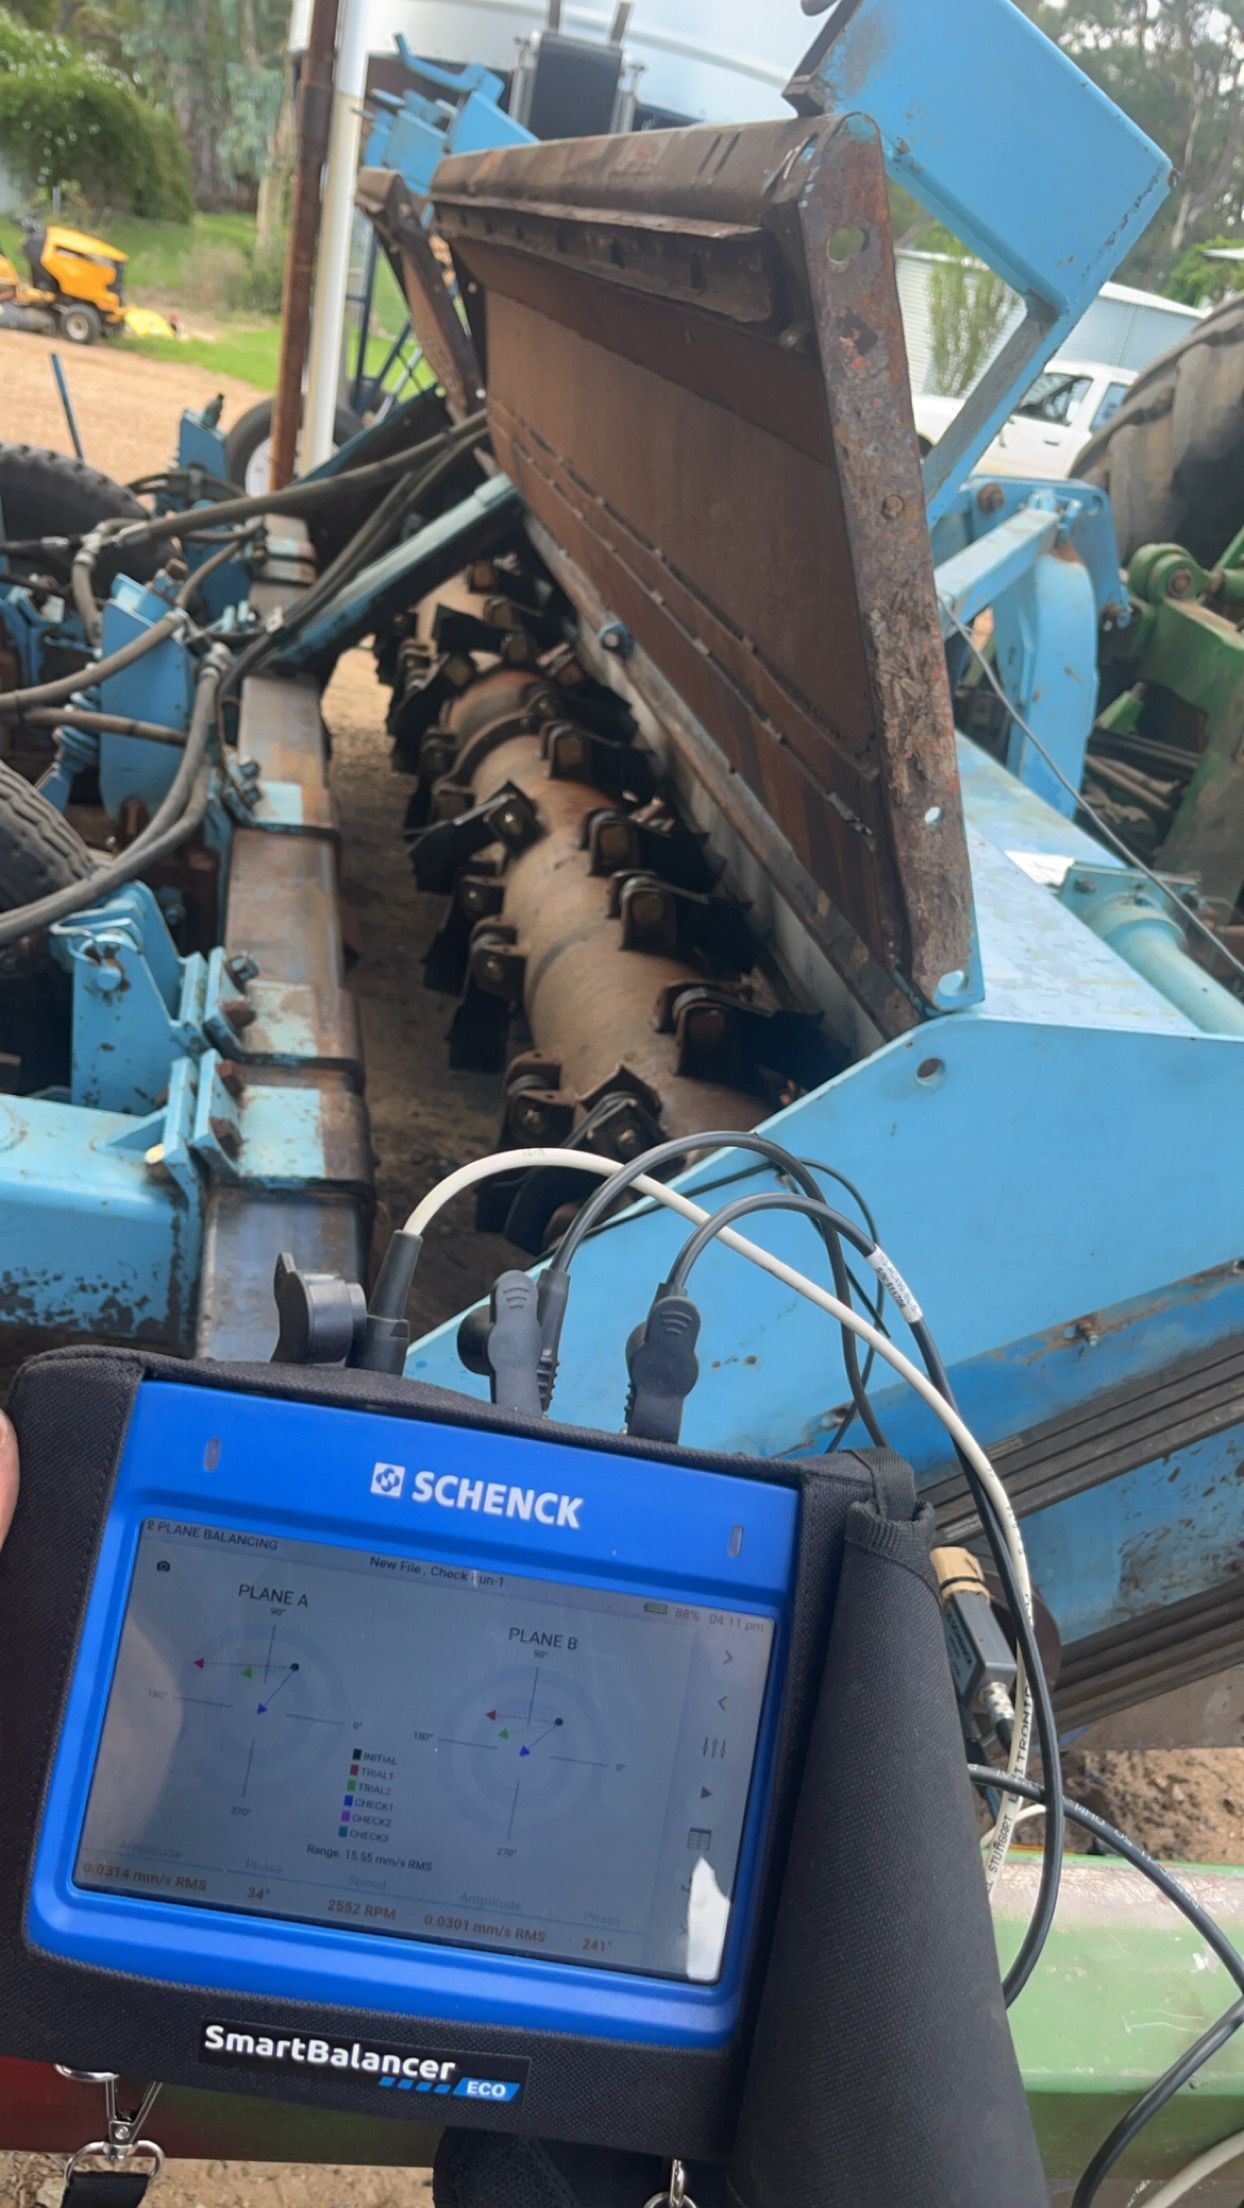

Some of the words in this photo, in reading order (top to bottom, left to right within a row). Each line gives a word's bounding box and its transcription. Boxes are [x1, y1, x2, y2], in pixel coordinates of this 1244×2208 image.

[411, 1470, 584, 1530] SCHENCK
[147, 1519, 154, 1531] 2
[157, 1521, 200, 1538] PLANE
[203, 1531, 278, 1551] BALANCING
[369, 1555, 397, 1570] New
[400, 1560, 421, 1575] File
[430, 1565, 468, 1582] Check
[470, 1570, 505, 1587] un-1
[238, 1583, 294, 1606] PLANE
[297, 1593, 309, 1608] A
[745, 1622, 764, 1633] pm
[508, 1627, 562, 1649] PLANE
[567, 1636, 579, 1651] B
[363, 1752, 397, 1766] INITIAL
[361, 1766, 394, 1780] TRIAL1
[358, 1782, 392, 1796] TRIAL2
[354, 1797, 394, 1812] CHECK1
[352, 1813, 392, 1828] CHECK2
[349, 1828, 389, 1843] CHECK3
[346, 1848, 373, 1864] 15.55
[375, 1854, 405, 1870] mm/s
[407, 1859, 433, 1872] RMS
[83, 1861, 130, 1879] 0.0314
[132, 1870, 172, 1887] mm/s
[175, 1876, 208, 1892] RMS
[348, 1874, 387, 1893] Speed
[327, 1898, 361, 1915] 2552
[364, 1904, 396, 1921] RPM
[460, 1892, 522, 1911] Amplitude
[423, 1913, 469, 1932] 0.0301
[473, 1922, 511, 1938] mm/s
[515, 1926, 546, 1943] RMS
[203, 2024, 456, 2081] SmartBalancer
[466, 2081, 507, 2098] ECO
